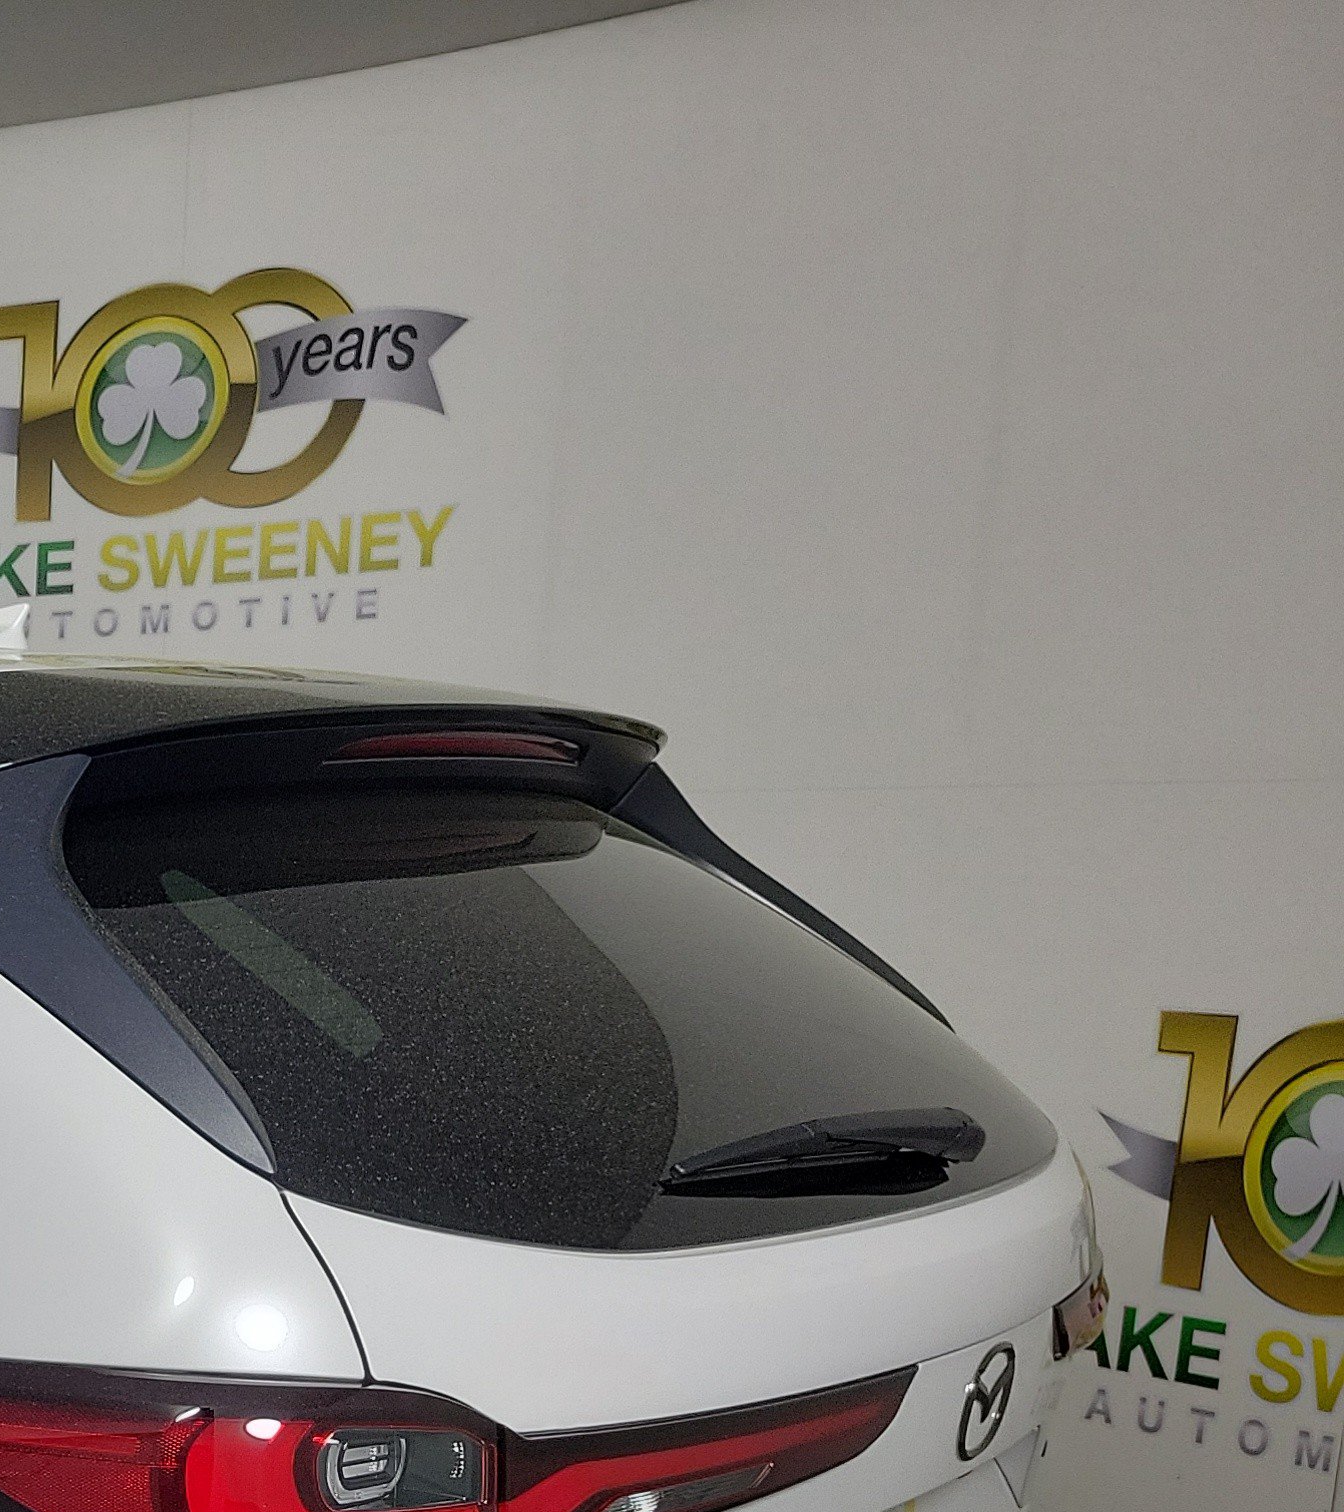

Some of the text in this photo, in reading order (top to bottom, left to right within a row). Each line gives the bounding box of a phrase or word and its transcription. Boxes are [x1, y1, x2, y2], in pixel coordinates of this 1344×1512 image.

[269, 322, 418, 399] years
[96, 503, 456, 592] SWEENEY
[23, 588, 379, 640] TOMOTIVE
[1084, 1306, 1227, 1391] KE
